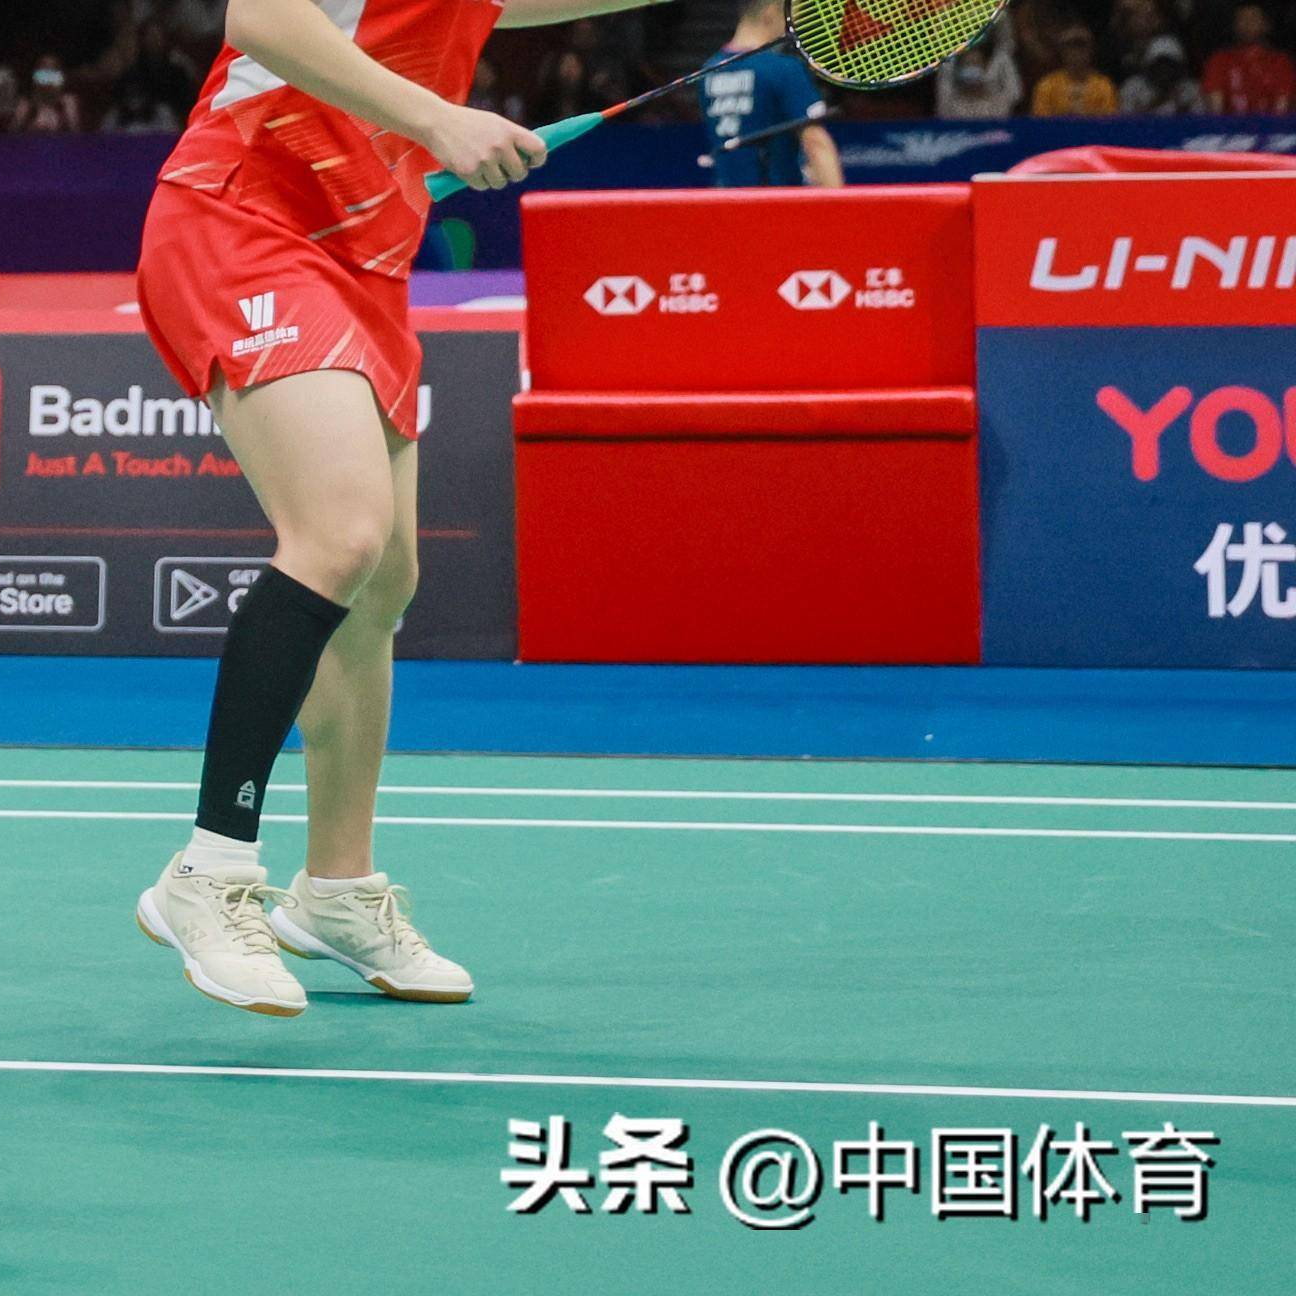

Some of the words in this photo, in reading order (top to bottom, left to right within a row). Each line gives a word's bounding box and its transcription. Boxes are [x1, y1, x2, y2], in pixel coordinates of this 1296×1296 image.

[28, 384, 223, 436] Badmi
[25, 451, 78, 477] Just
[81, 451, 106, 476] A
[110, 450, 192, 478] Touch
[16, 573, 37, 585] on
[39, 570, 65, 585] the
